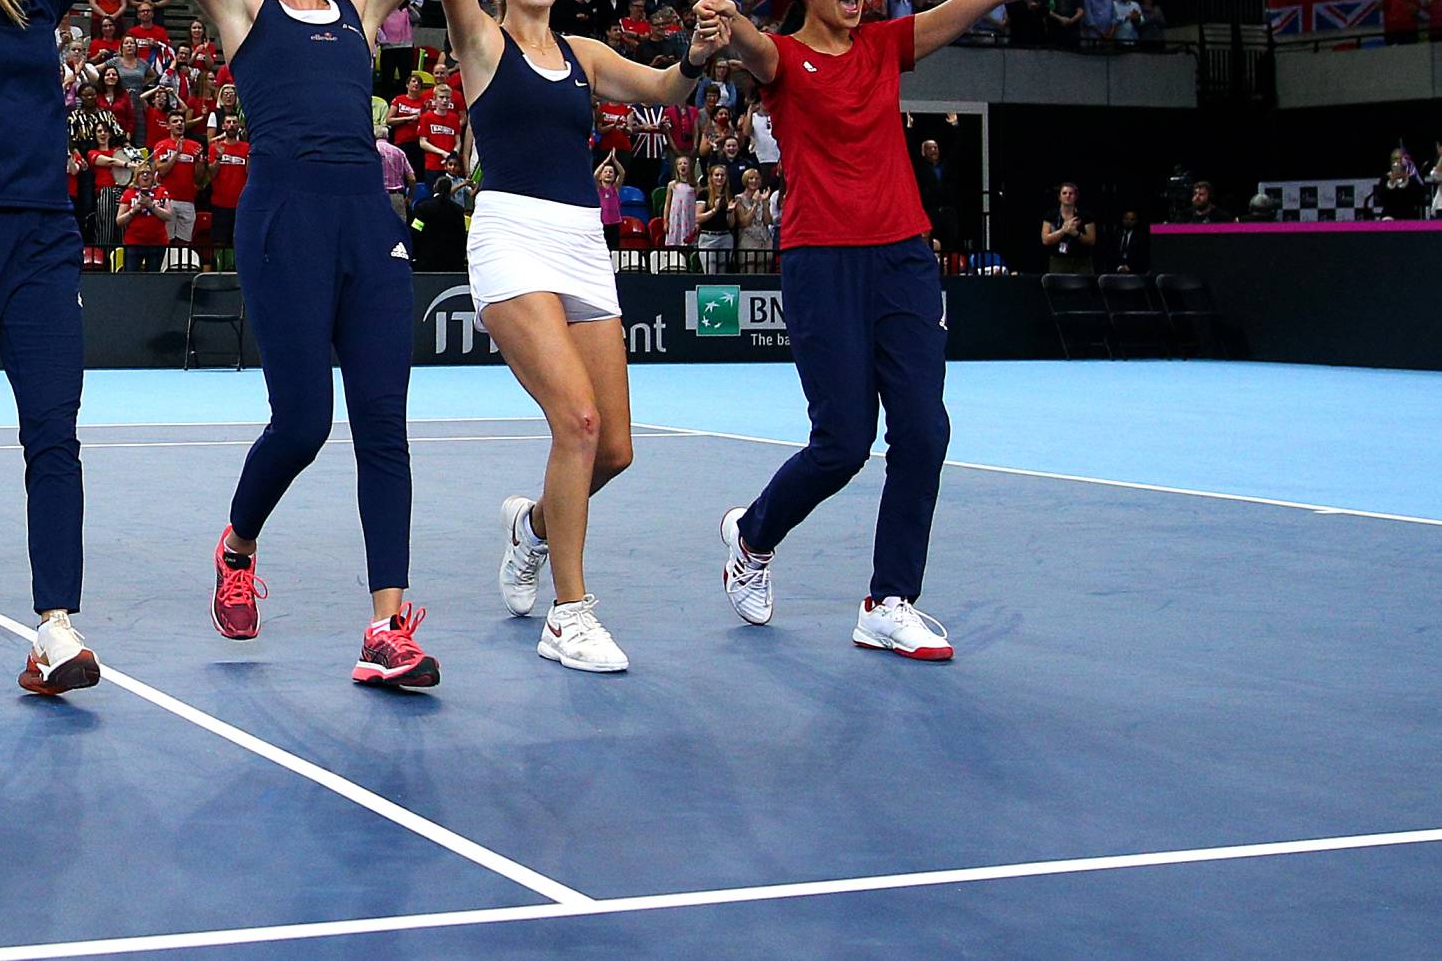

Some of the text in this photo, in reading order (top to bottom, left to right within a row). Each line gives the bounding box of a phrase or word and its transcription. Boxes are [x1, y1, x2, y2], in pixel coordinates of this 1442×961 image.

[436, 312, 499, 354] IT
[621, 314, 667, 353] nt
[750, 333, 773, 346] The
